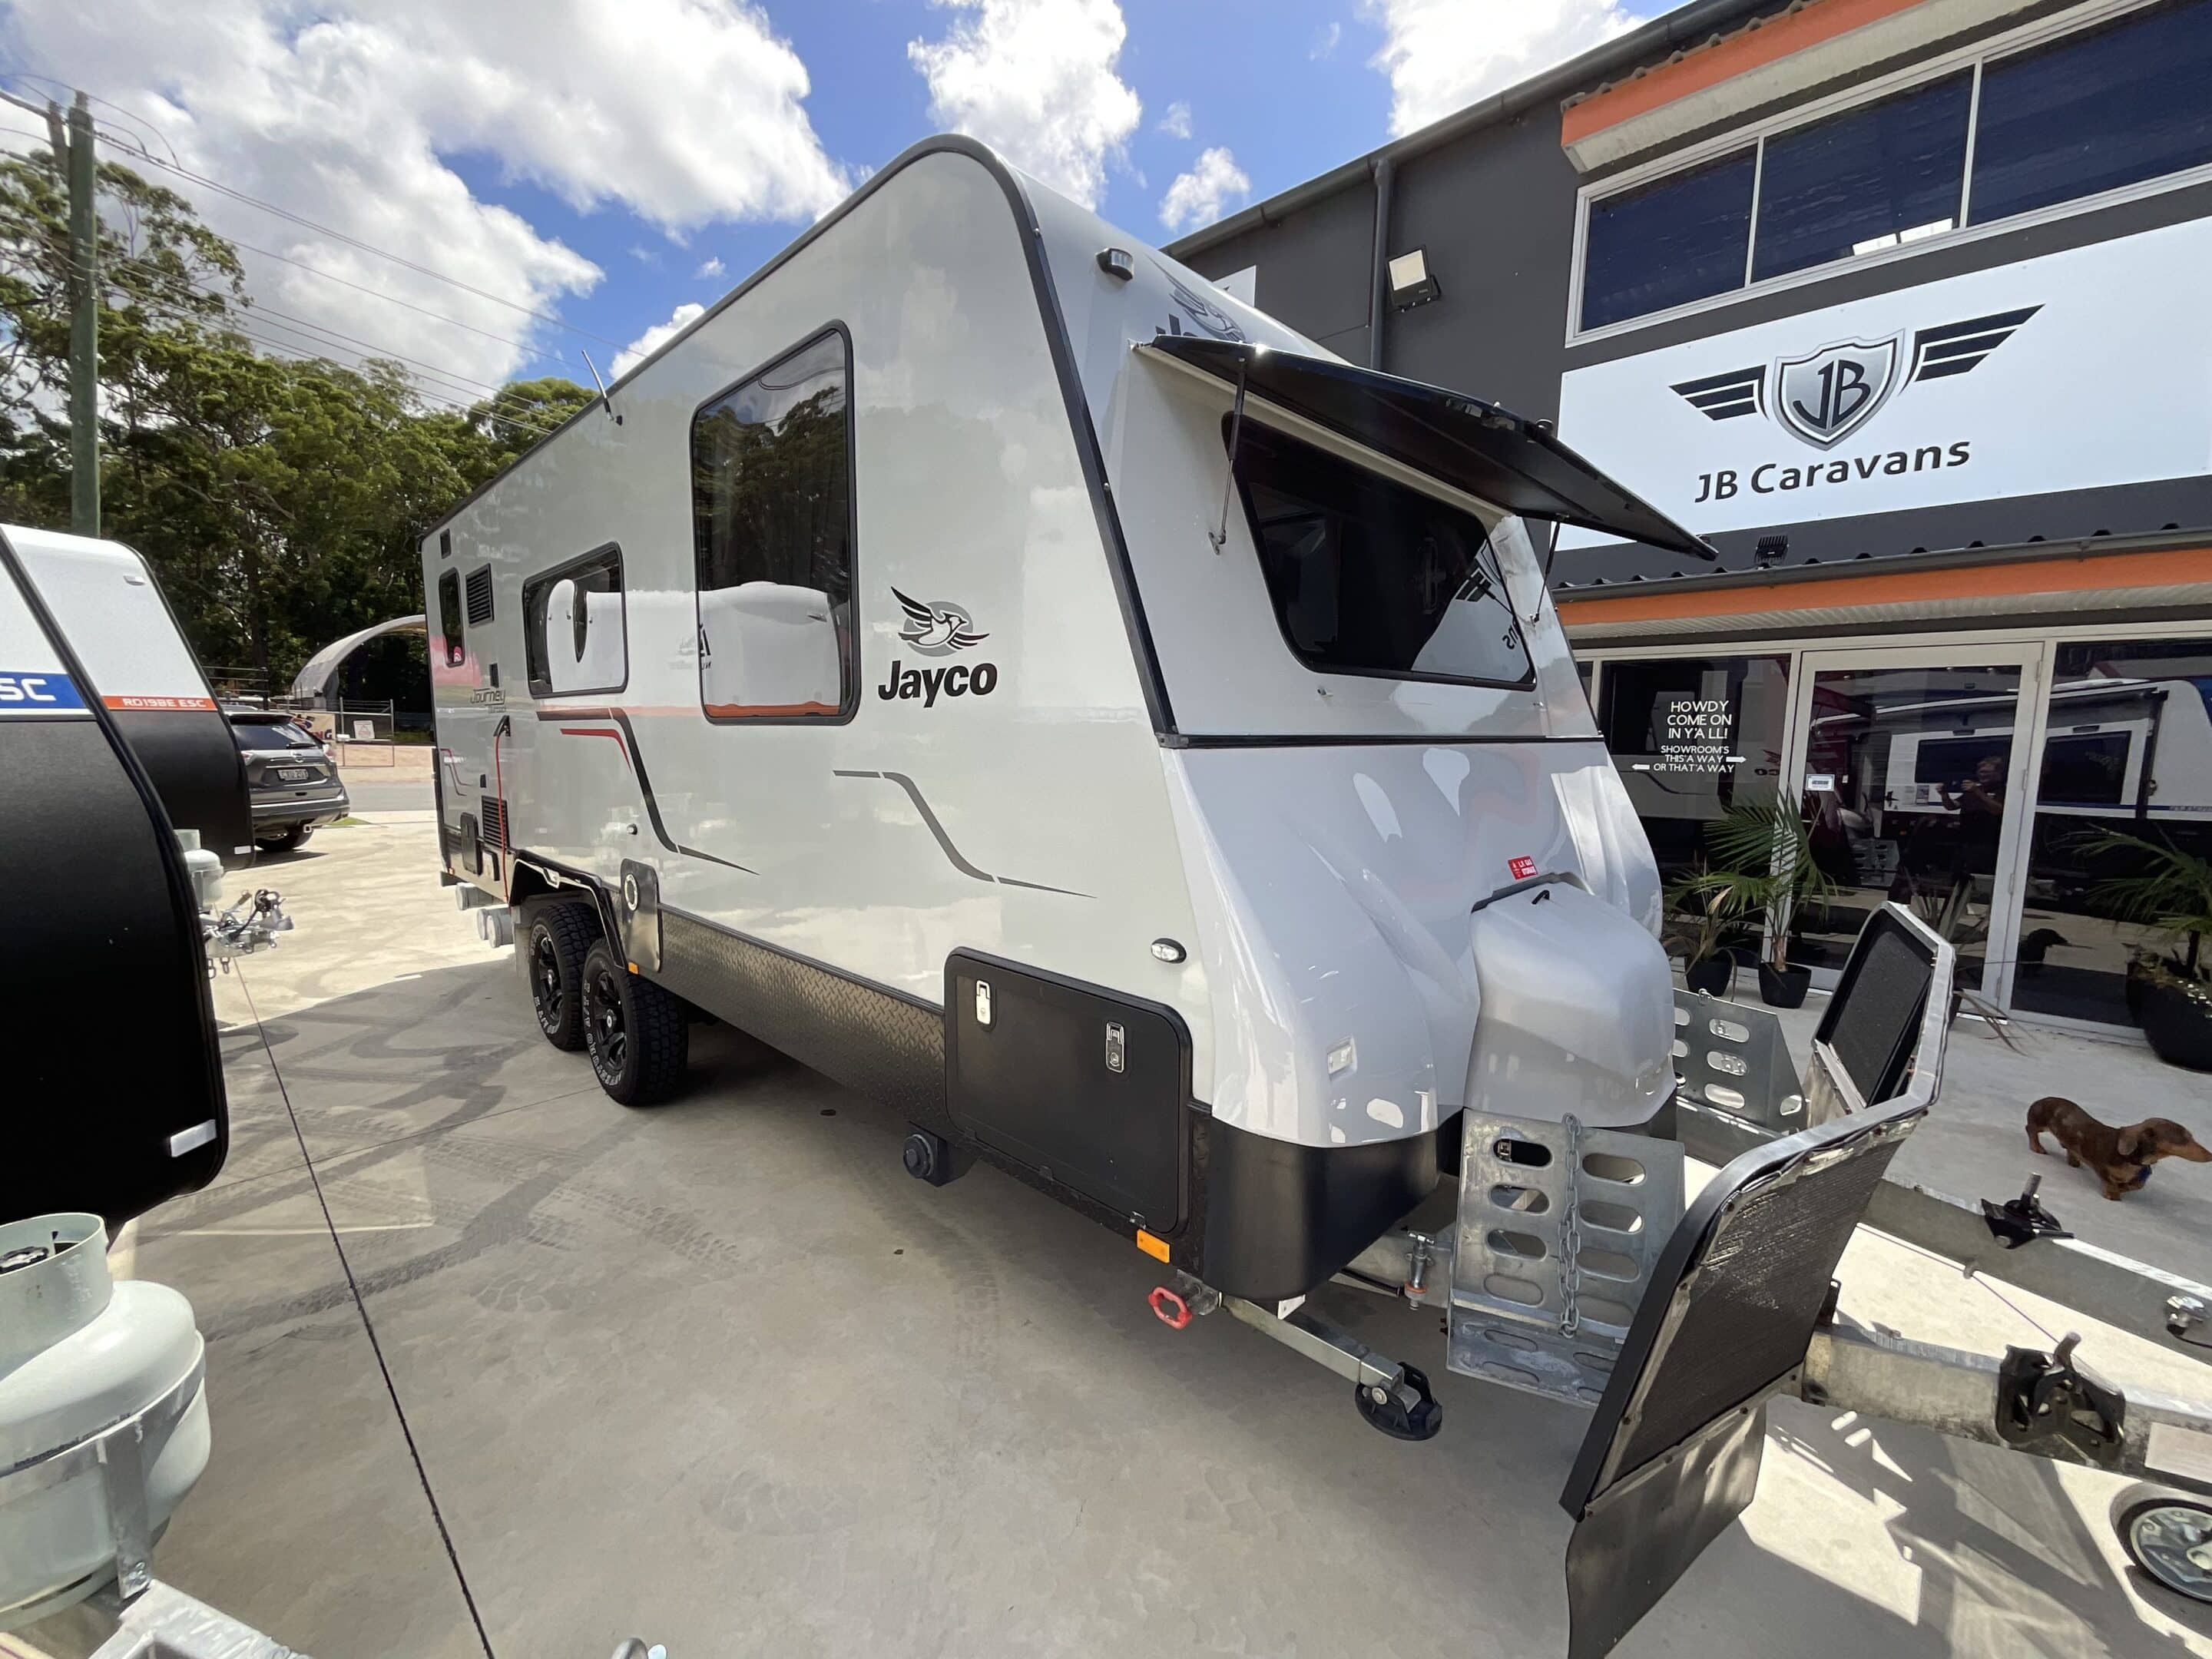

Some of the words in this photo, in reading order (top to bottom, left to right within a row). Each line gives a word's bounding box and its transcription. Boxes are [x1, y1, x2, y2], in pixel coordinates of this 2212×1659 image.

[1793, 359, 1871, 430] JB
[1694, 469, 1738, 503] JB
[1750, 441, 1971, 494] Caravans
[878, 660, 998, 708] Jayco
[178, 699, 207, 707] ESC
[1671, 700, 1729, 712] HOWDY
[1667, 714, 1707, 726] COME
[1710, 714, 1732, 725] ON
[1668, 727, 1681, 739] IN
[1661, 745, 1730, 754] SHOWROOM'S
[1697, 755, 1724, 763] WAY
[1654, 763, 1667, 772] OR
[1707, 764, 1734, 773] WAY
